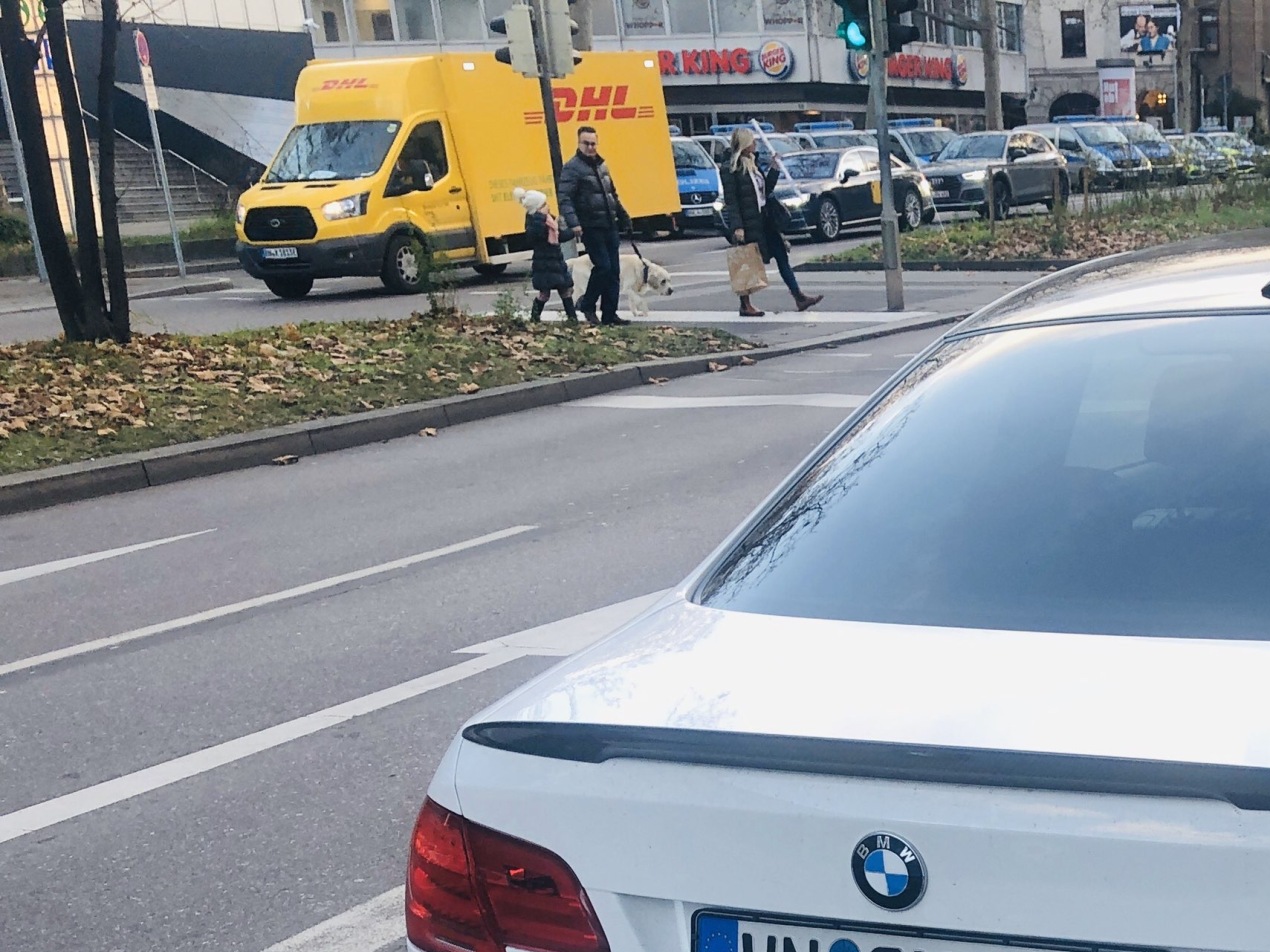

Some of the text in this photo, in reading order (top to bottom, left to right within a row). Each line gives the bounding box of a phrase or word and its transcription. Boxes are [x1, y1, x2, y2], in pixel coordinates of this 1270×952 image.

[682, 47, 751, 75] KING
[763, 55, 787, 71] KING
[321, 78, 368, 90] DHL
[552, 85, 638, 123] DHL
[856, 835, 916, 864] BMW
